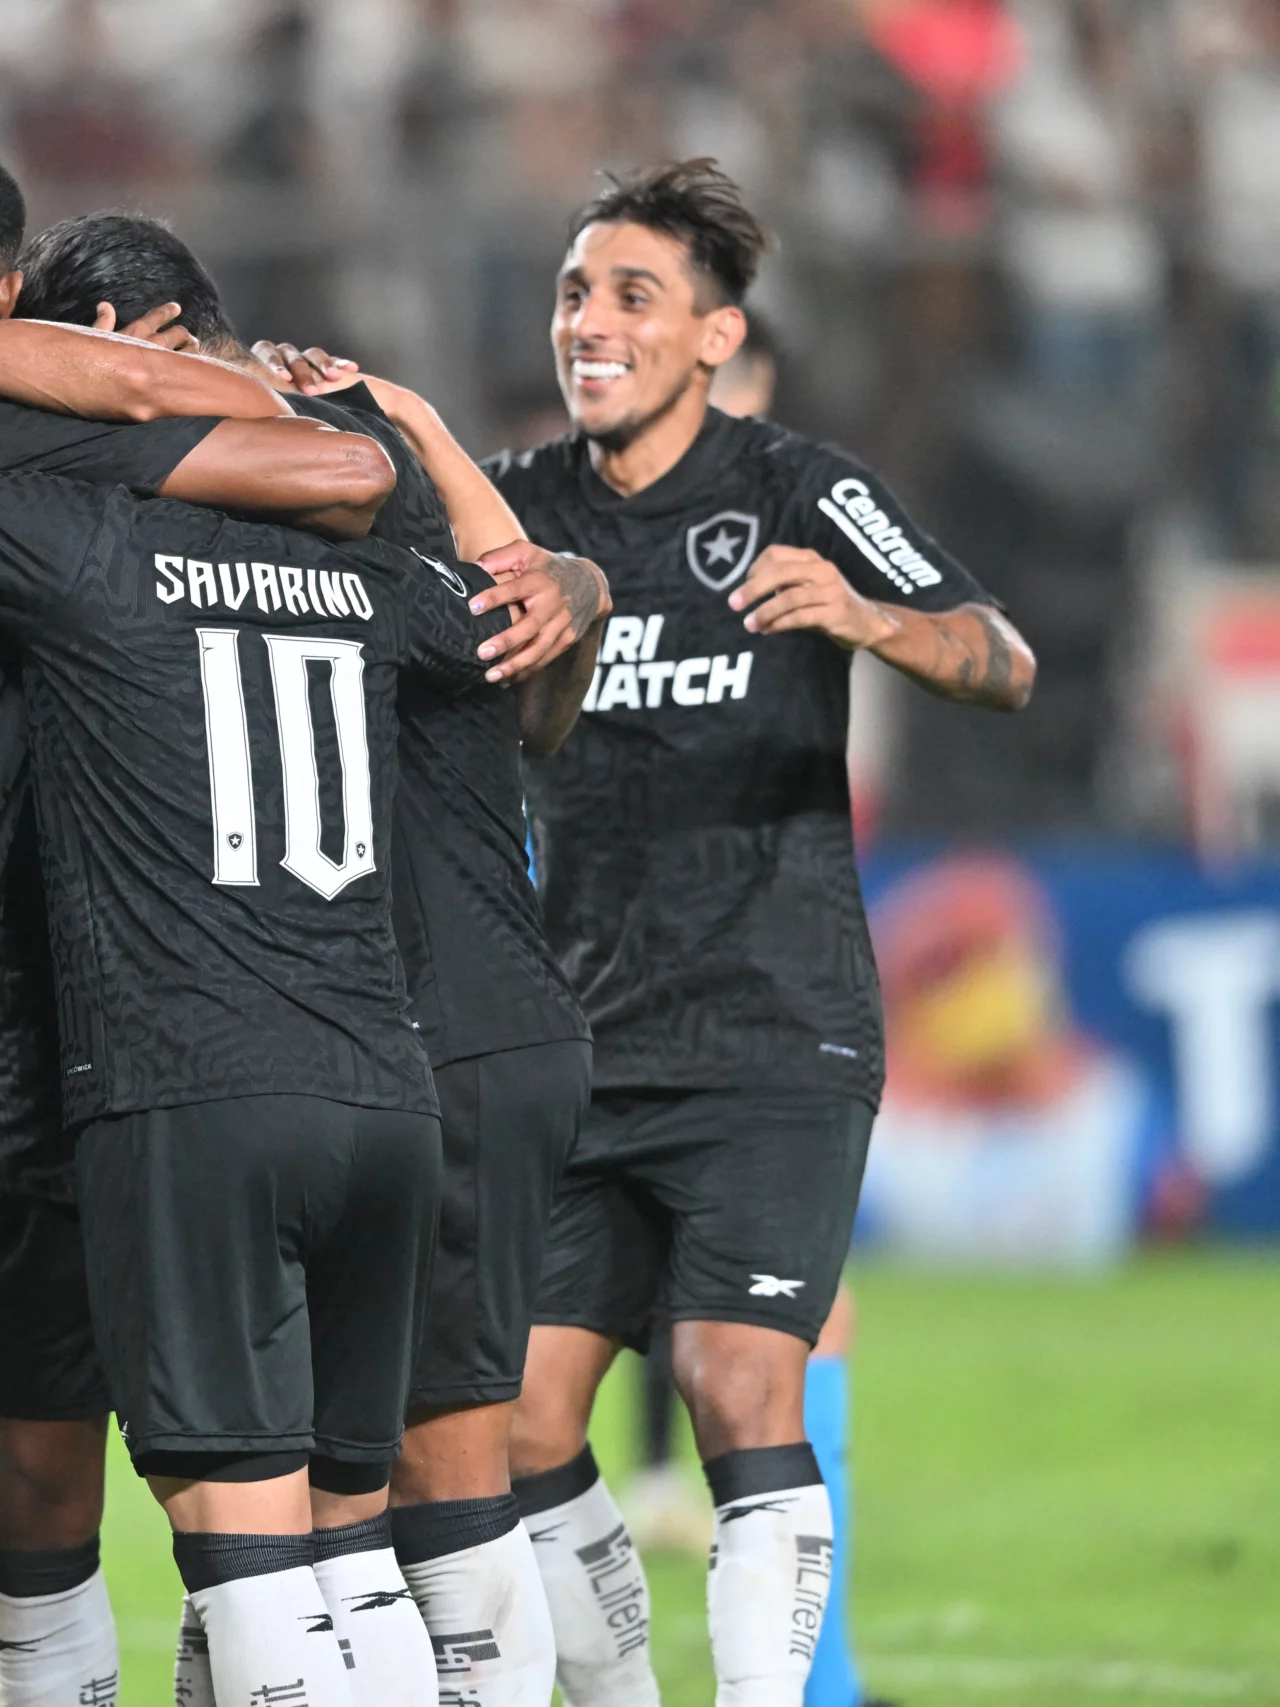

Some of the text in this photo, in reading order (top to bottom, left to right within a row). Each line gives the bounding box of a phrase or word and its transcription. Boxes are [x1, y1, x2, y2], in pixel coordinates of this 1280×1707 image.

[831, 478, 943, 588] Centrum
[155, 553, 374, 621] SAVARINO
[596, 614, 665, 664] RI
[195, 628, 377, 901] 10
